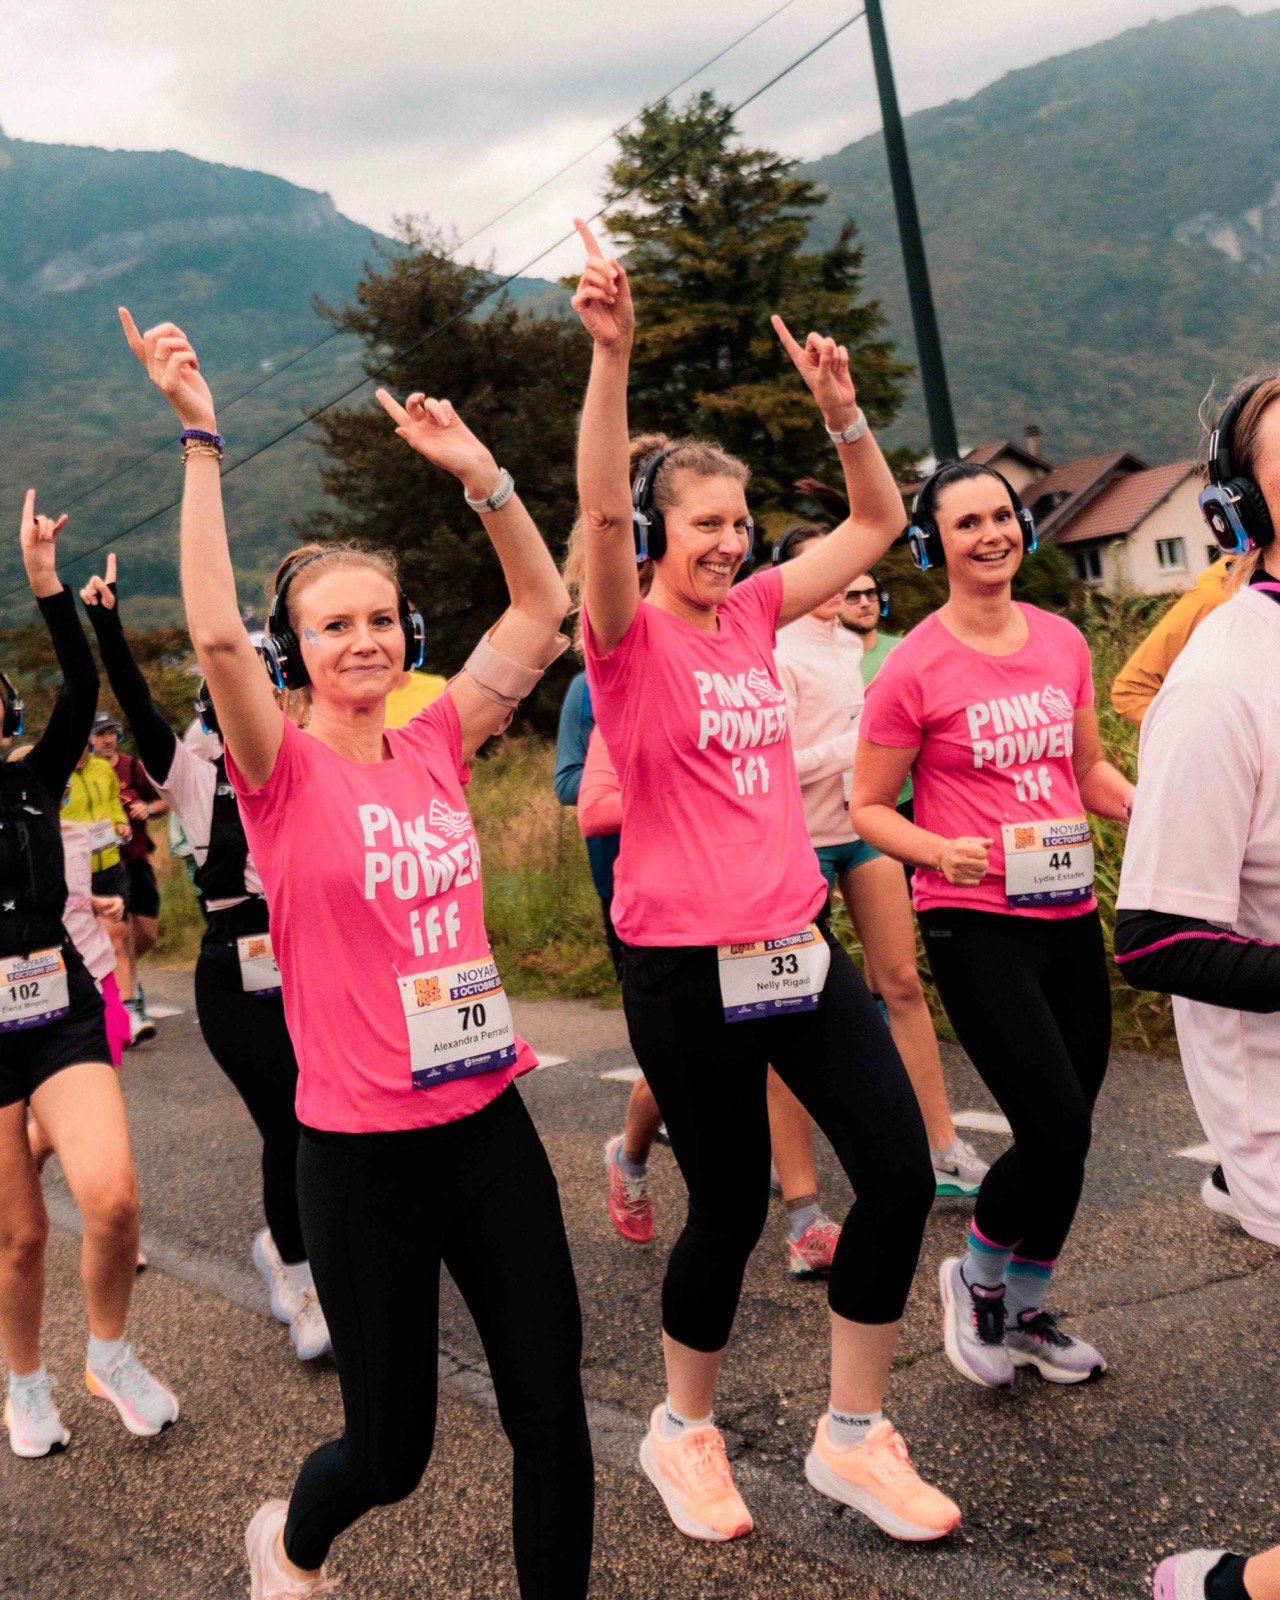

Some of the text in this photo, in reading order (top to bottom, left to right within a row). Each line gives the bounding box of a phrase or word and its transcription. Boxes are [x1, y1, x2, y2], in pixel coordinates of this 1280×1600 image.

[966, 691, 1051, 740] PINK
[1012, 765, 1053, 802] iff
[1045, 838, 1050, 846] 3
[1051, 835, 1083, 846] OCTOBRE
[1049, 851, 1072, 870] 44
[1034, 874, 1055, 884] Lydie
[410, 901, 461, 957] iff
[767, 941, 773, 950] 3
[774, 934, 801, 948] OCTOBRE
[13, 955, 54, 971] NOYAREY
[771, 954, 799, 976] 33
[9, 982, 40, 1002] 102
[452, 989, 459, 999] 3
[460, 979, 496, 997] OCTOBRE
[757, 980, 780, 991] Nelly
[458, 1003, 487, 1031] 70
[433, 1035, 479, 1053] Alexandra
